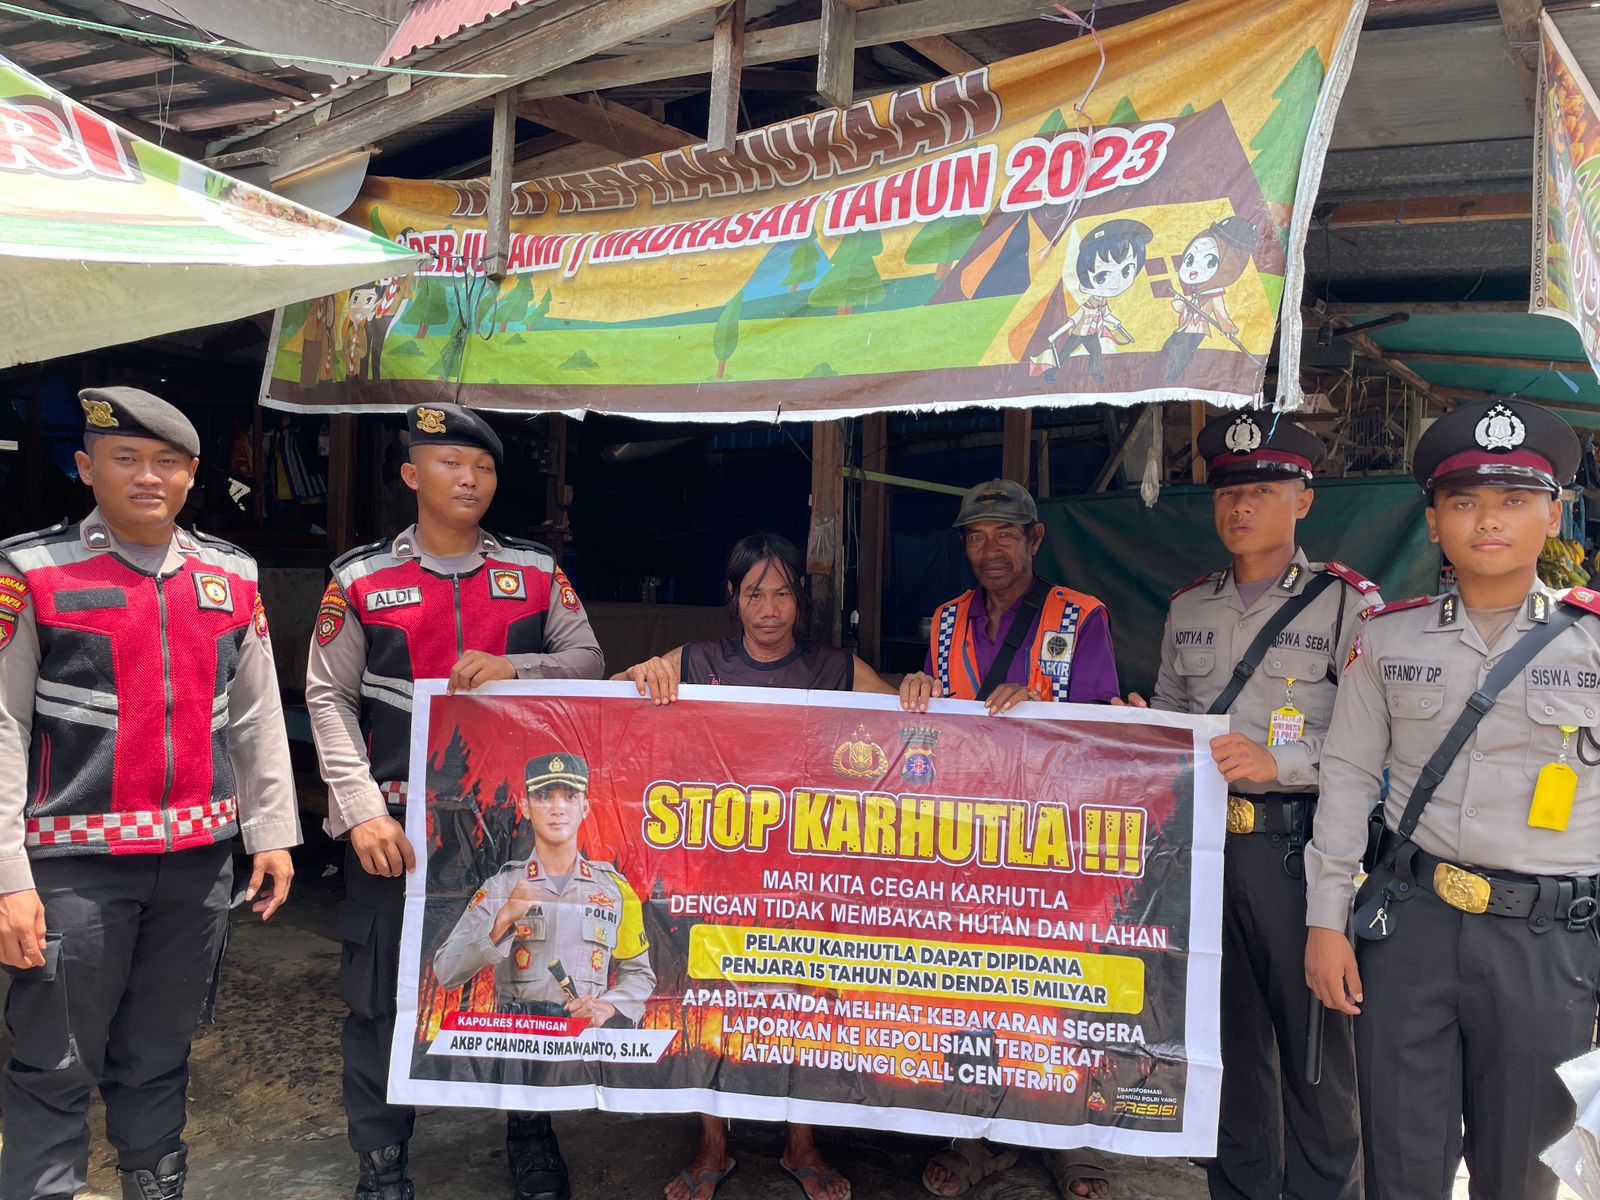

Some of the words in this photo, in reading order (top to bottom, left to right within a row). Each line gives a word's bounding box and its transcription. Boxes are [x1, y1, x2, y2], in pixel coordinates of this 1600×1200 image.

[591, 194, 818, 261] MADRASAH
[827, 148, 993, 233] TAHUN
[1003, 127, 1171, 208] 2023
[375, 589, 411, 607] ALDI
[1175, 631, 1202, 645] ADITYA
[1206, 631, 1214, 645] R
[1305, 635, 1330, 652] SEBA
[1383, 664, 1423, 682] AFFANDY
[1426, 666, 1442, 684] DP
[1531, 668, 1571, 687] SISWA
[645, 782, 783, 850] STOP
[791, 790, 1072, 871] KARHUTLA
[1083, 806, 1143, 876] !!!
[763, 870, 813, 891] MARI
[820, 873, 865, 895] KITA
[870, 876, 944, 900] CEGAH
[951, 882, 1069, 910] KARHUTLA
[585, 907, 617, 924] POLRI
[671, 894, 757, 916] DENGAN
[764, 899, 825, 921] TIDAK
[831, 903, 953, 932] MEMBAKAR
[959, 913, 1030, 937] HUTAN
[1037, 918, 1084, 940] DAN
[1091, 923, 1168, 949] LAHAN
[746, 934, 815, 954] PELAKU
[819, 939, 917, 963] KARHUTLA
[920, 948, 983, 969] DAPAT
[986, 952, 1082, 977] DIPIDANA
[721, 956, 806, 977] PENJARA
[809, 962, 825, 977] 15
[828, 964, 892, 985] TAHUN
[897, 969, 937, 990] DAN
[941, 974, 1008, 995] DENDA
[1010, 979, 1029, 995] 15
[1033, 980, 1107, 1005] MILYAR
[457, 1015, 513, 1028] KAPOLRES
[515, 1018, 568, 1032] KATINGAN
[681, 988, 767, 1010] APABILA
[770, 992, 830, 1014] ANDA
[833, 998, 923, 1023] MELIHAT
[927, 1005, 1057, 1037] KEBAKARAN
[1062, 1019, 1146, 1045] SEGERA
[450, 1035, 483, 1051] AKBP
[485, 1037, 540, 1054] CHANDRA
[543, 1039, 617, 1060] ISMAWANTO,
[620, 1041, 653, 1057] S.I.K.
[723, 1015, 831, 1042] LAPORKAN
[836, 1024, 860, 1046] KE
[865, 1027, 991, 1057] KEPOLISIAN
[995, 1038, 1105, 1068] TERDEKAT
[742, 1043, 795, 1065] ATAU
[800, 1050, 895, 1077] HUBUNGI
[900, 1057, 954, 1081] CALL
[958, 1063, 1041, 1091] CENTER
[1045, 1072, 1078, 1094] 110
[1116, 1087, 1162, 1095] TRANSFORMASI
[1113, 1101, 1178, 1116] PRESISI
